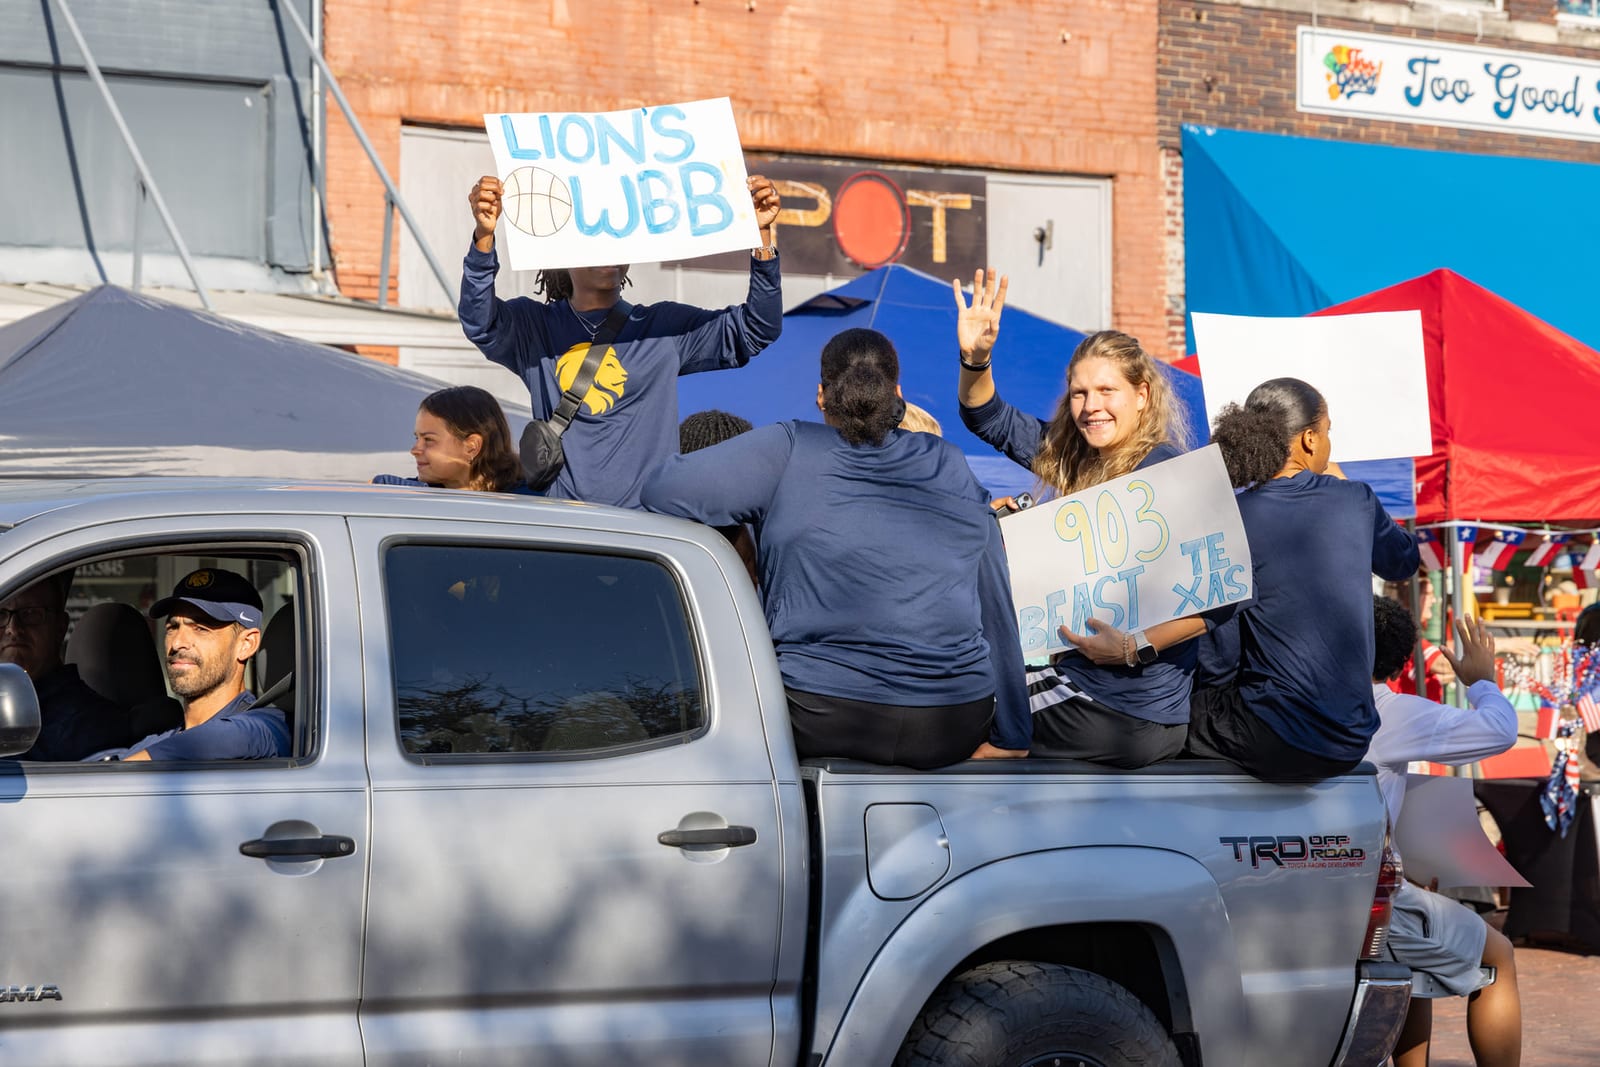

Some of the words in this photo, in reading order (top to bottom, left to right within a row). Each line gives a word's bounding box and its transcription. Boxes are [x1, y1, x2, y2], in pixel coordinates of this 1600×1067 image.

[1404, 56, 1474, 107] Too
[1484, 63, 1583, 119] Good
[500, 105, 695, 165] LION'S
[569, 161, 734, 239] WBB
[1054, 479, 1170, 576] 903
[1180, 532, 1231, 576] TE
[1019, 565, 1145, 650] BEAST
[1172, 564, 1248, 616] XAS
[1219, 836, 1308, 869] TRD
[1309, 836, 1350, 847] OFF
[1311, 849, 1366, 861] ROAD
